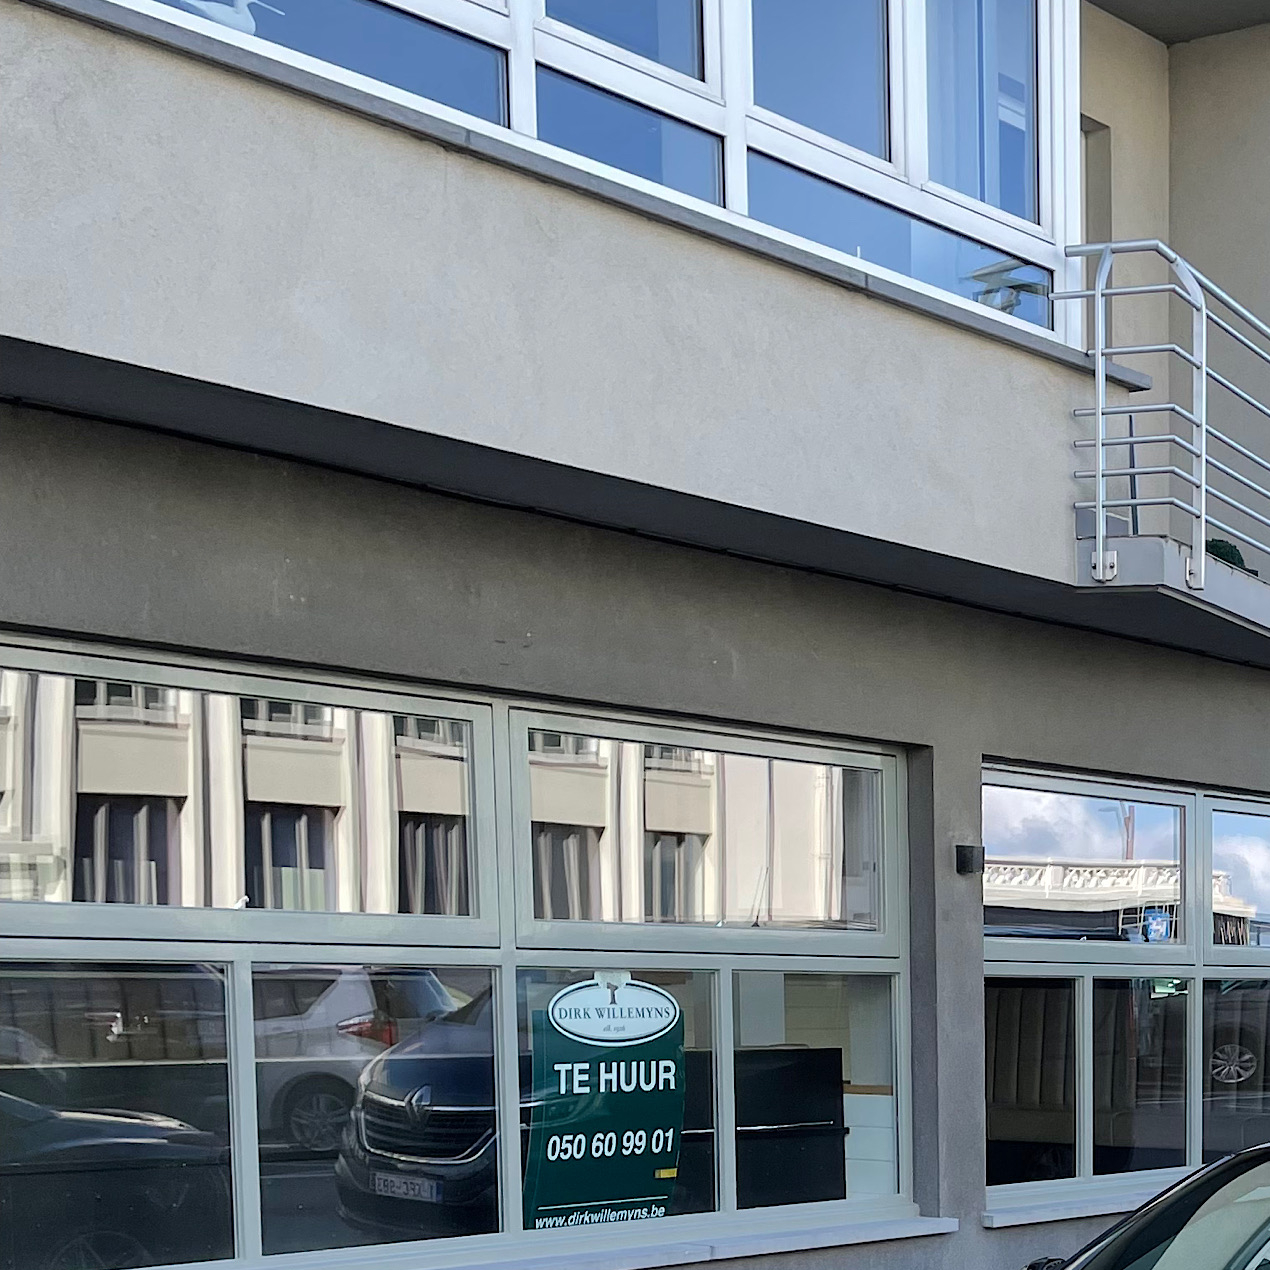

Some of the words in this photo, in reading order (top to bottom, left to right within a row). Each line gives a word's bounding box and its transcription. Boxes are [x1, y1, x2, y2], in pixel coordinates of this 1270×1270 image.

[558, 1007, 592, 1020] DIRK
[595, 1005, 671, 1020] WILLEMYNS
[553, 1062, 591, 1095] TE
[599, 1059, 676, 1093] HUUR
[547, 1133, 586, 1161] 050
[591, 1132, 617, 1158] 60
[621, 1130, 647, 1156] 99
[651, 1127, 674, 1154] 01
[535, 1204, 666, 1230] www.dirkwillemyns.be
